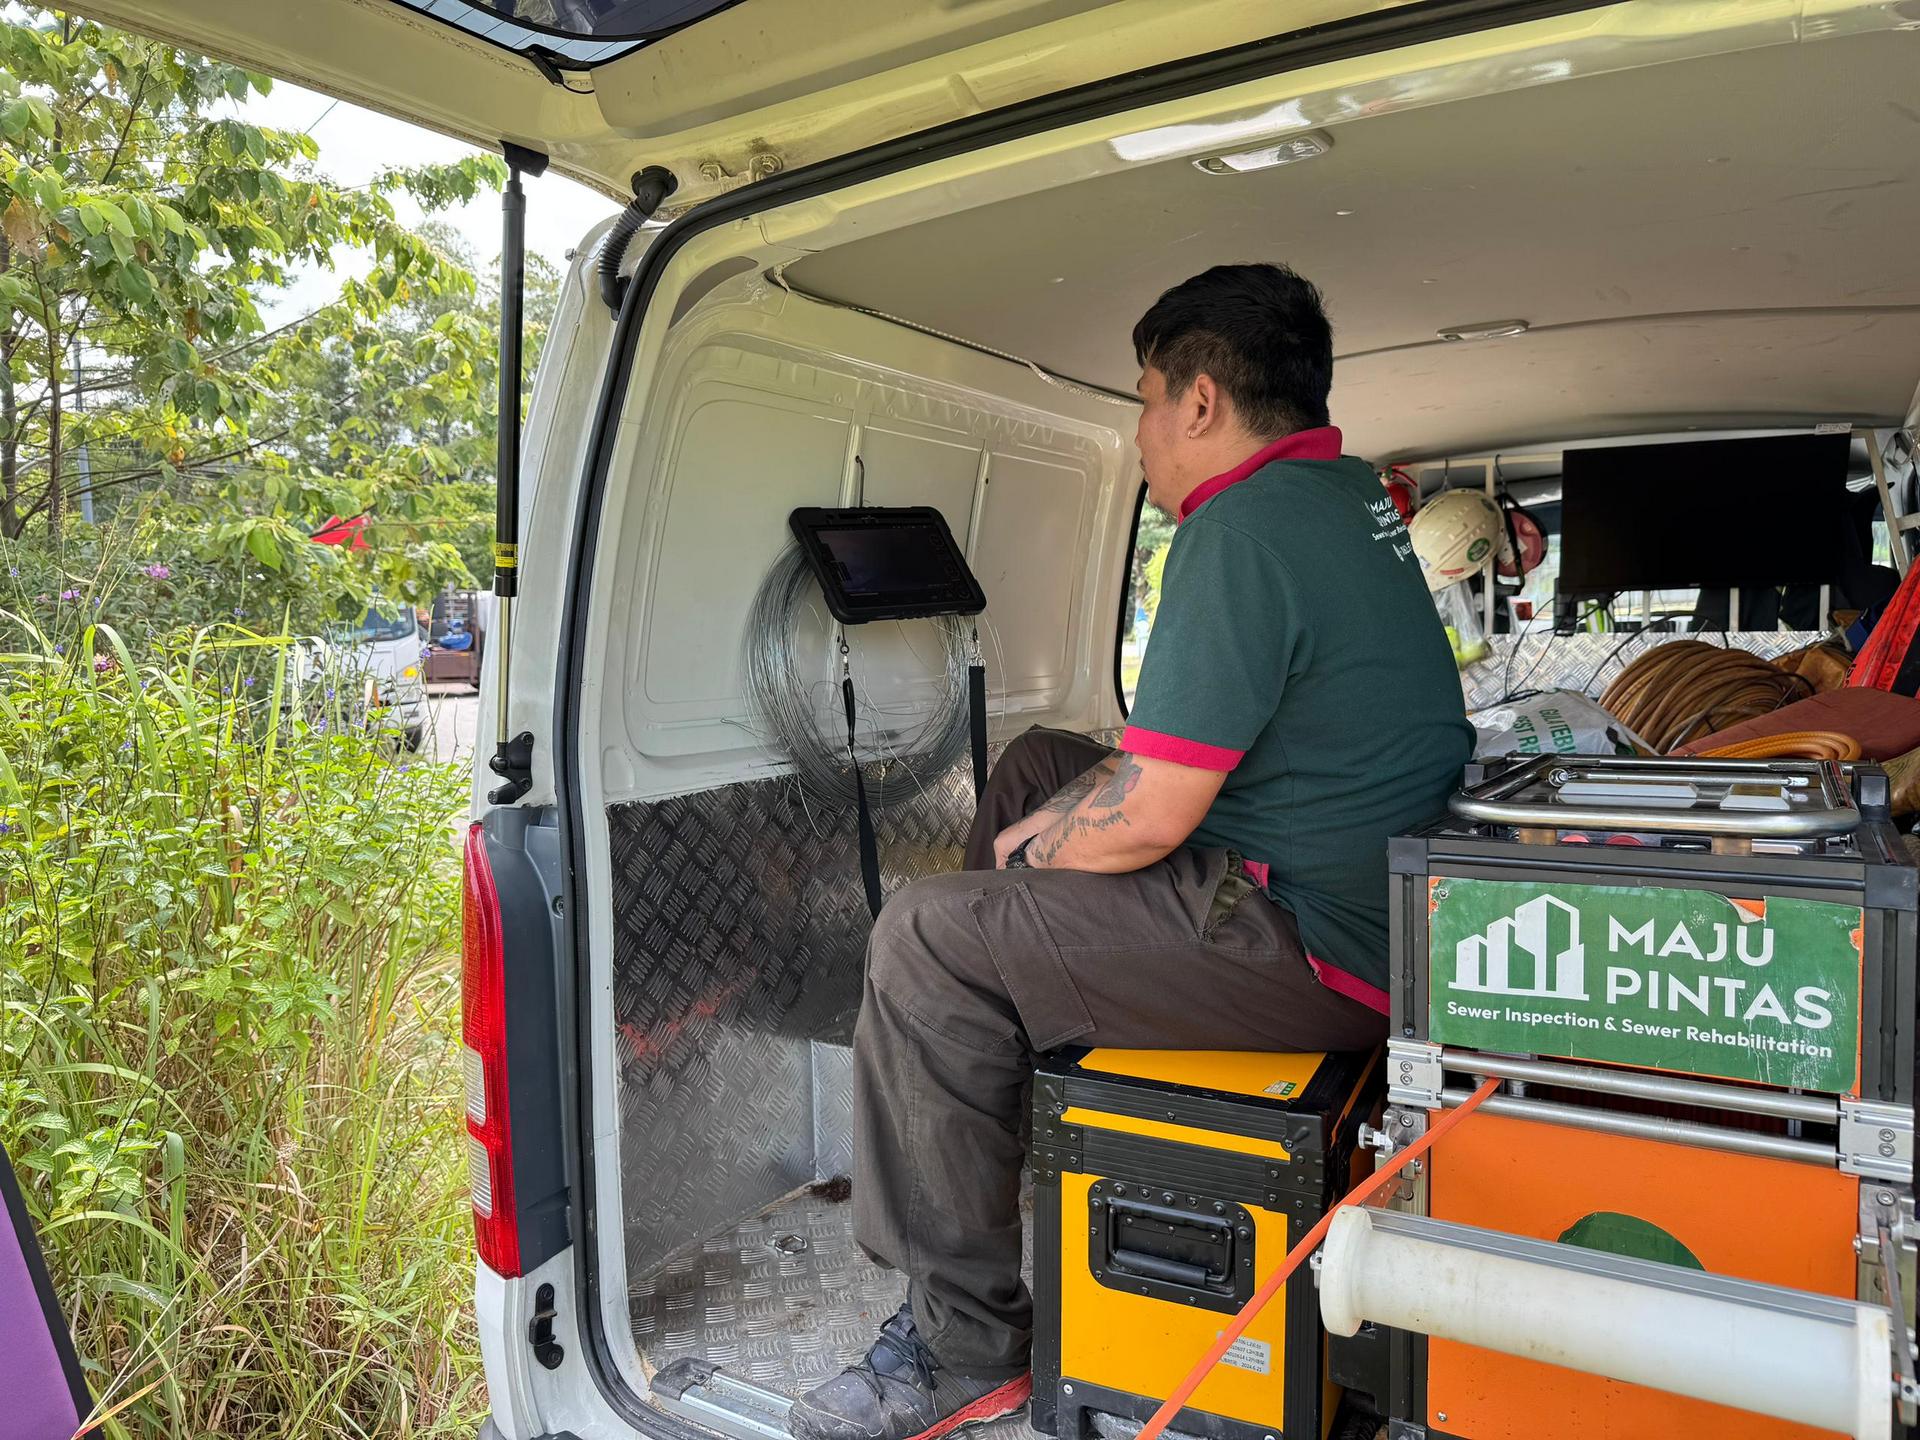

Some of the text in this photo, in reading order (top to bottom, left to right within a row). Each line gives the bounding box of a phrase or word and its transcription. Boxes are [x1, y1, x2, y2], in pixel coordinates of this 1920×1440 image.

[1370, 496, 1393, 514] MAJU
[1608, 914, 1774, 967] MAJU
[1606, 966, 1832, 1029] PINTAS
[1447, 1001, 1832, 1058] Sewer Inspection & Sewer Rehabilitation
